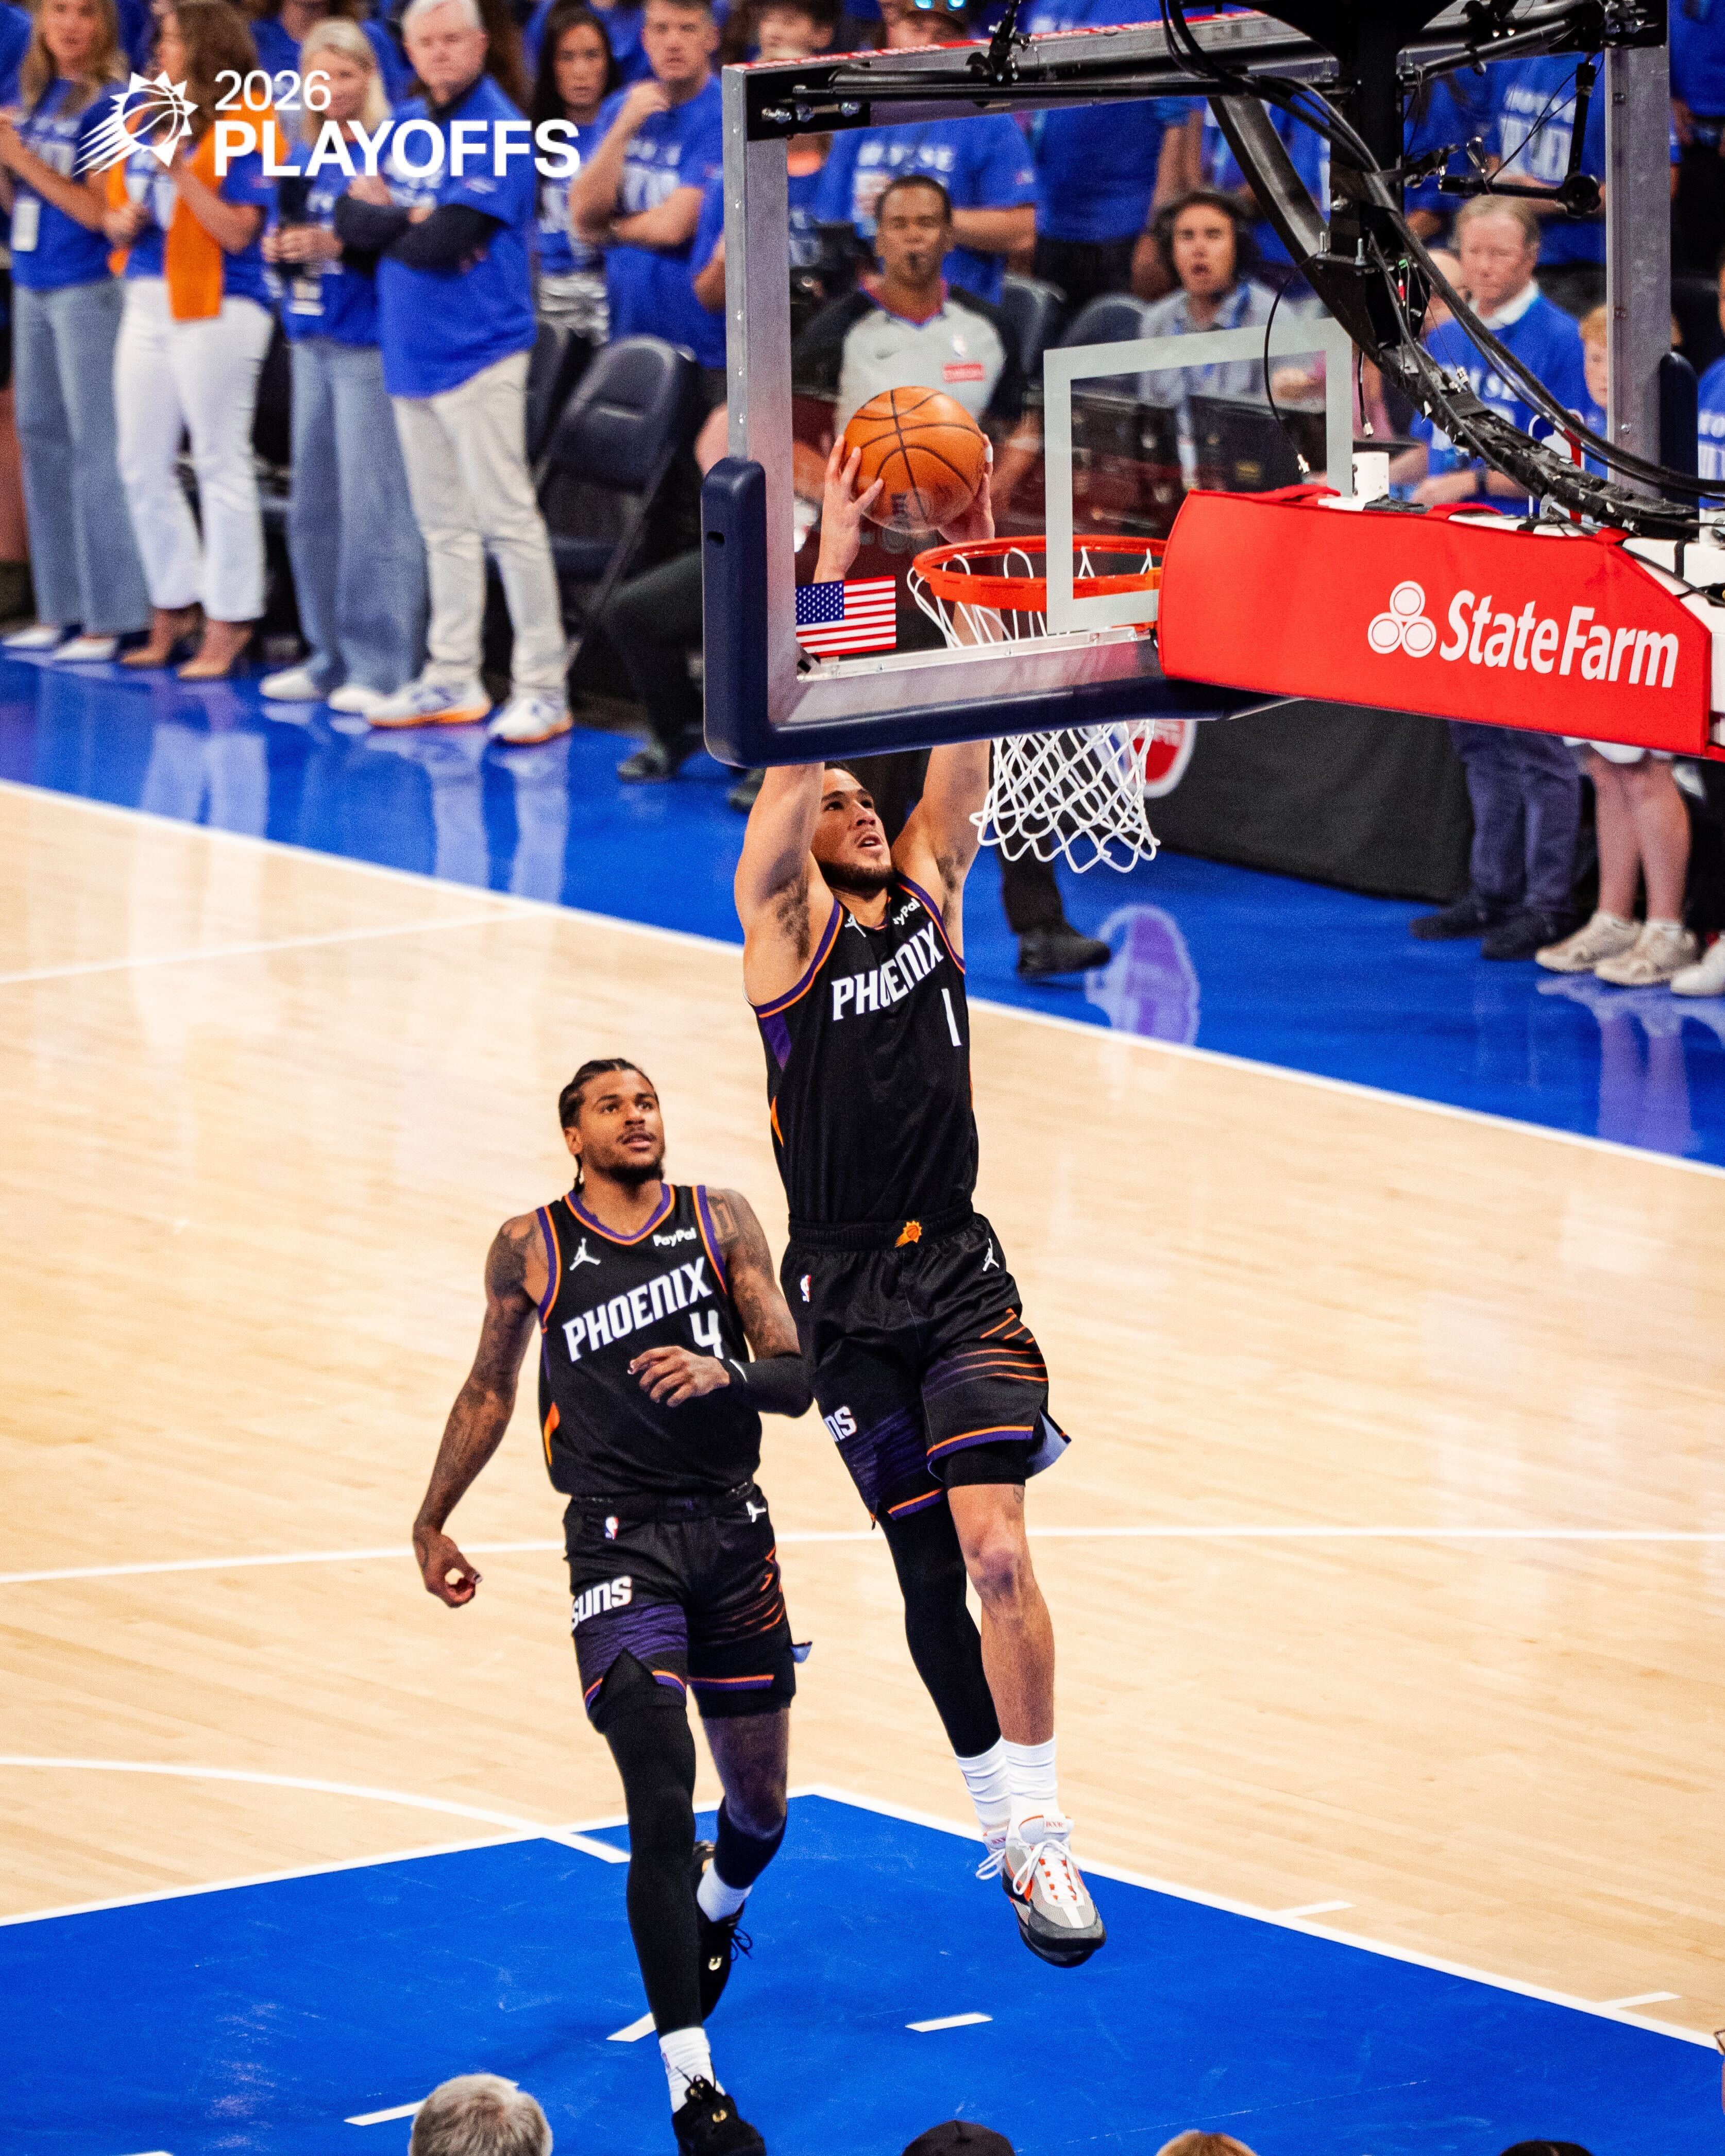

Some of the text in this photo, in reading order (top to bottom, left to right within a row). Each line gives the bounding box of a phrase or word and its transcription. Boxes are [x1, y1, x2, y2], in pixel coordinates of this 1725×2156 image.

[892, 897, 921, 926] yPal
[941, 988, 962, 1047] 1
[653, 1227, 697, 1247] PayPal
[562, 1257, 713, 1362] PHOENIX
[689, 1310, 724, 1360] 4
